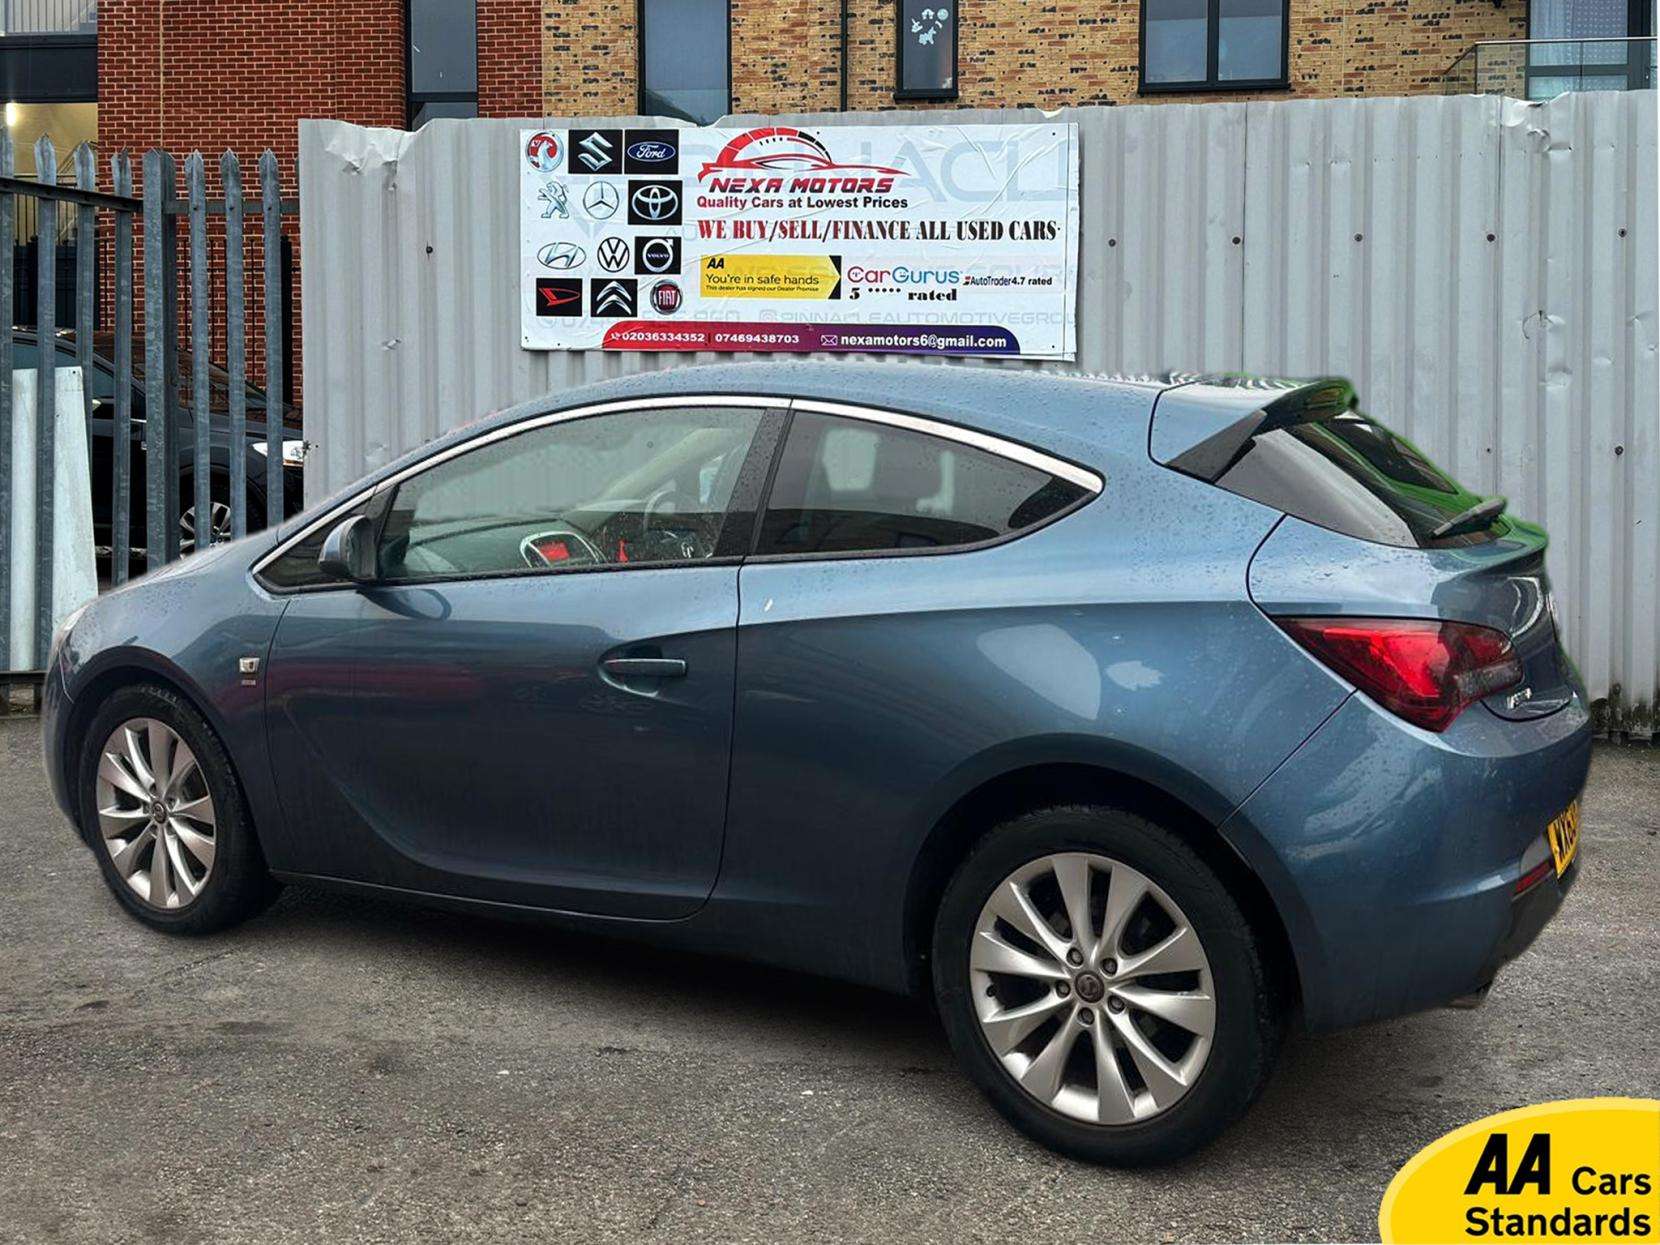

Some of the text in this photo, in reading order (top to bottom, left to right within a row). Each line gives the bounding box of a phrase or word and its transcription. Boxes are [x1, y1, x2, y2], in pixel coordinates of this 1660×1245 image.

[636, 144, 666, 159] Ford
[709, 178, 894, 193] NEXA MOTORS
[697, 196, 908, 211] Quality Cars at Lowest Prices
[697, 220, 726, 239] WE
[917, 220, 951, 240] ALL
[956, 220, 1004, 241] USED
[1008, 221, 1057, 241] CARS
[706, 257, 725, 269] AA
[706, 274, 819, 285] You're in safe hands
[847, 266, 960, 283] CarGurus
[1028, 277, 1053, 286] rated
[658, 290, 676, 305] FIAT
[849, 288, 957, 301] 5 rated
[841, 335, 1007, 349] nexamotors6@gmail.com
